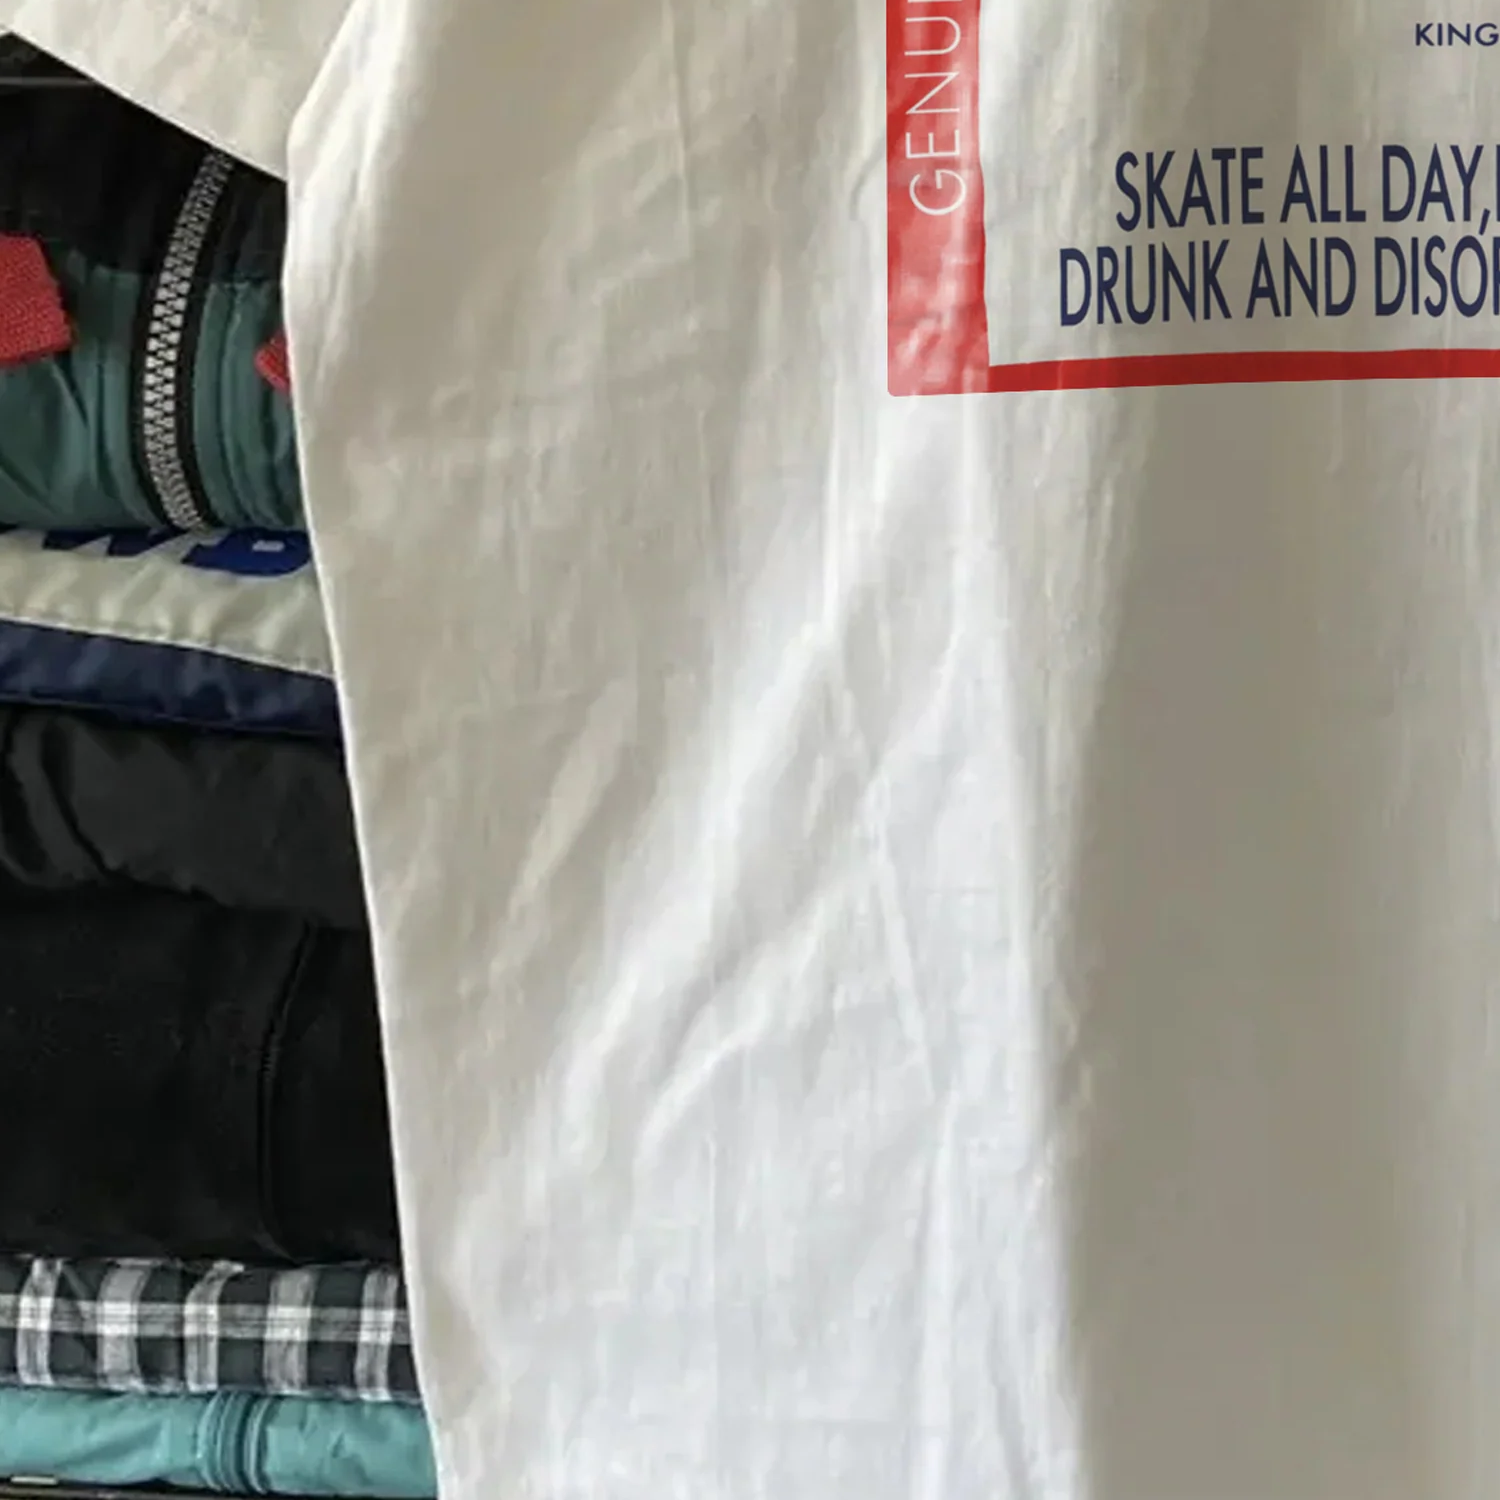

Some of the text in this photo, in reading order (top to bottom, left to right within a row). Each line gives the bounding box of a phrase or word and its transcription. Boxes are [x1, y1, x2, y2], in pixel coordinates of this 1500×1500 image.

[1415, 22, 1500, 48] KING
[1114, 145, 1264, 234] SKATE
[1280, 144, 1367, 225] ALL
[1058, 237, 1233, 328] DRUNK
[1245, 235, 1358, 320] AND
